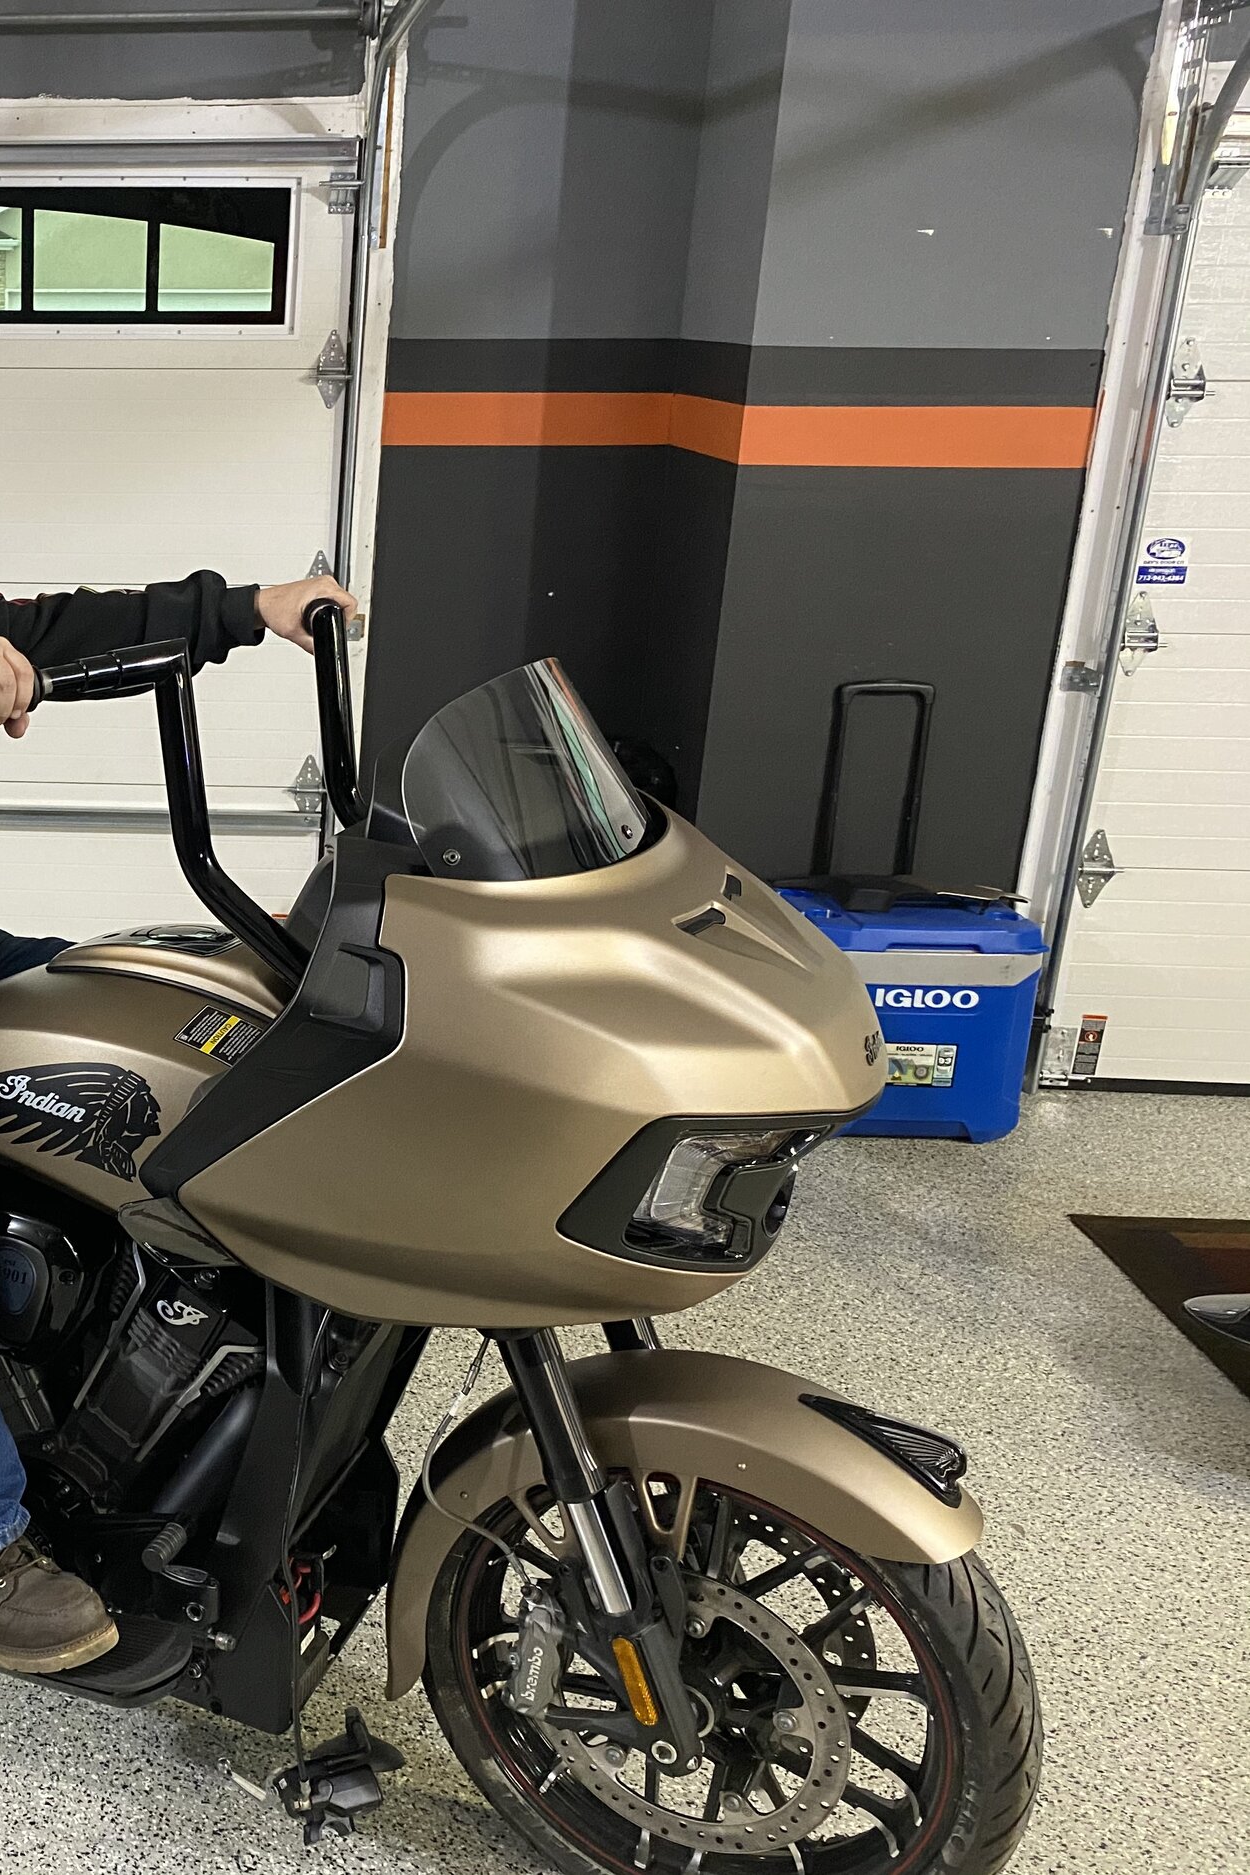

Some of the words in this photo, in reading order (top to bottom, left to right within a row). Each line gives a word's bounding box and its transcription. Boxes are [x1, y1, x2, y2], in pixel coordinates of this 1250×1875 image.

[875, 988, 979, 1008] IGLOO
[210, 1024, 232, 1044] CAUTION
[521, 1646, 543, 1701] brembo
